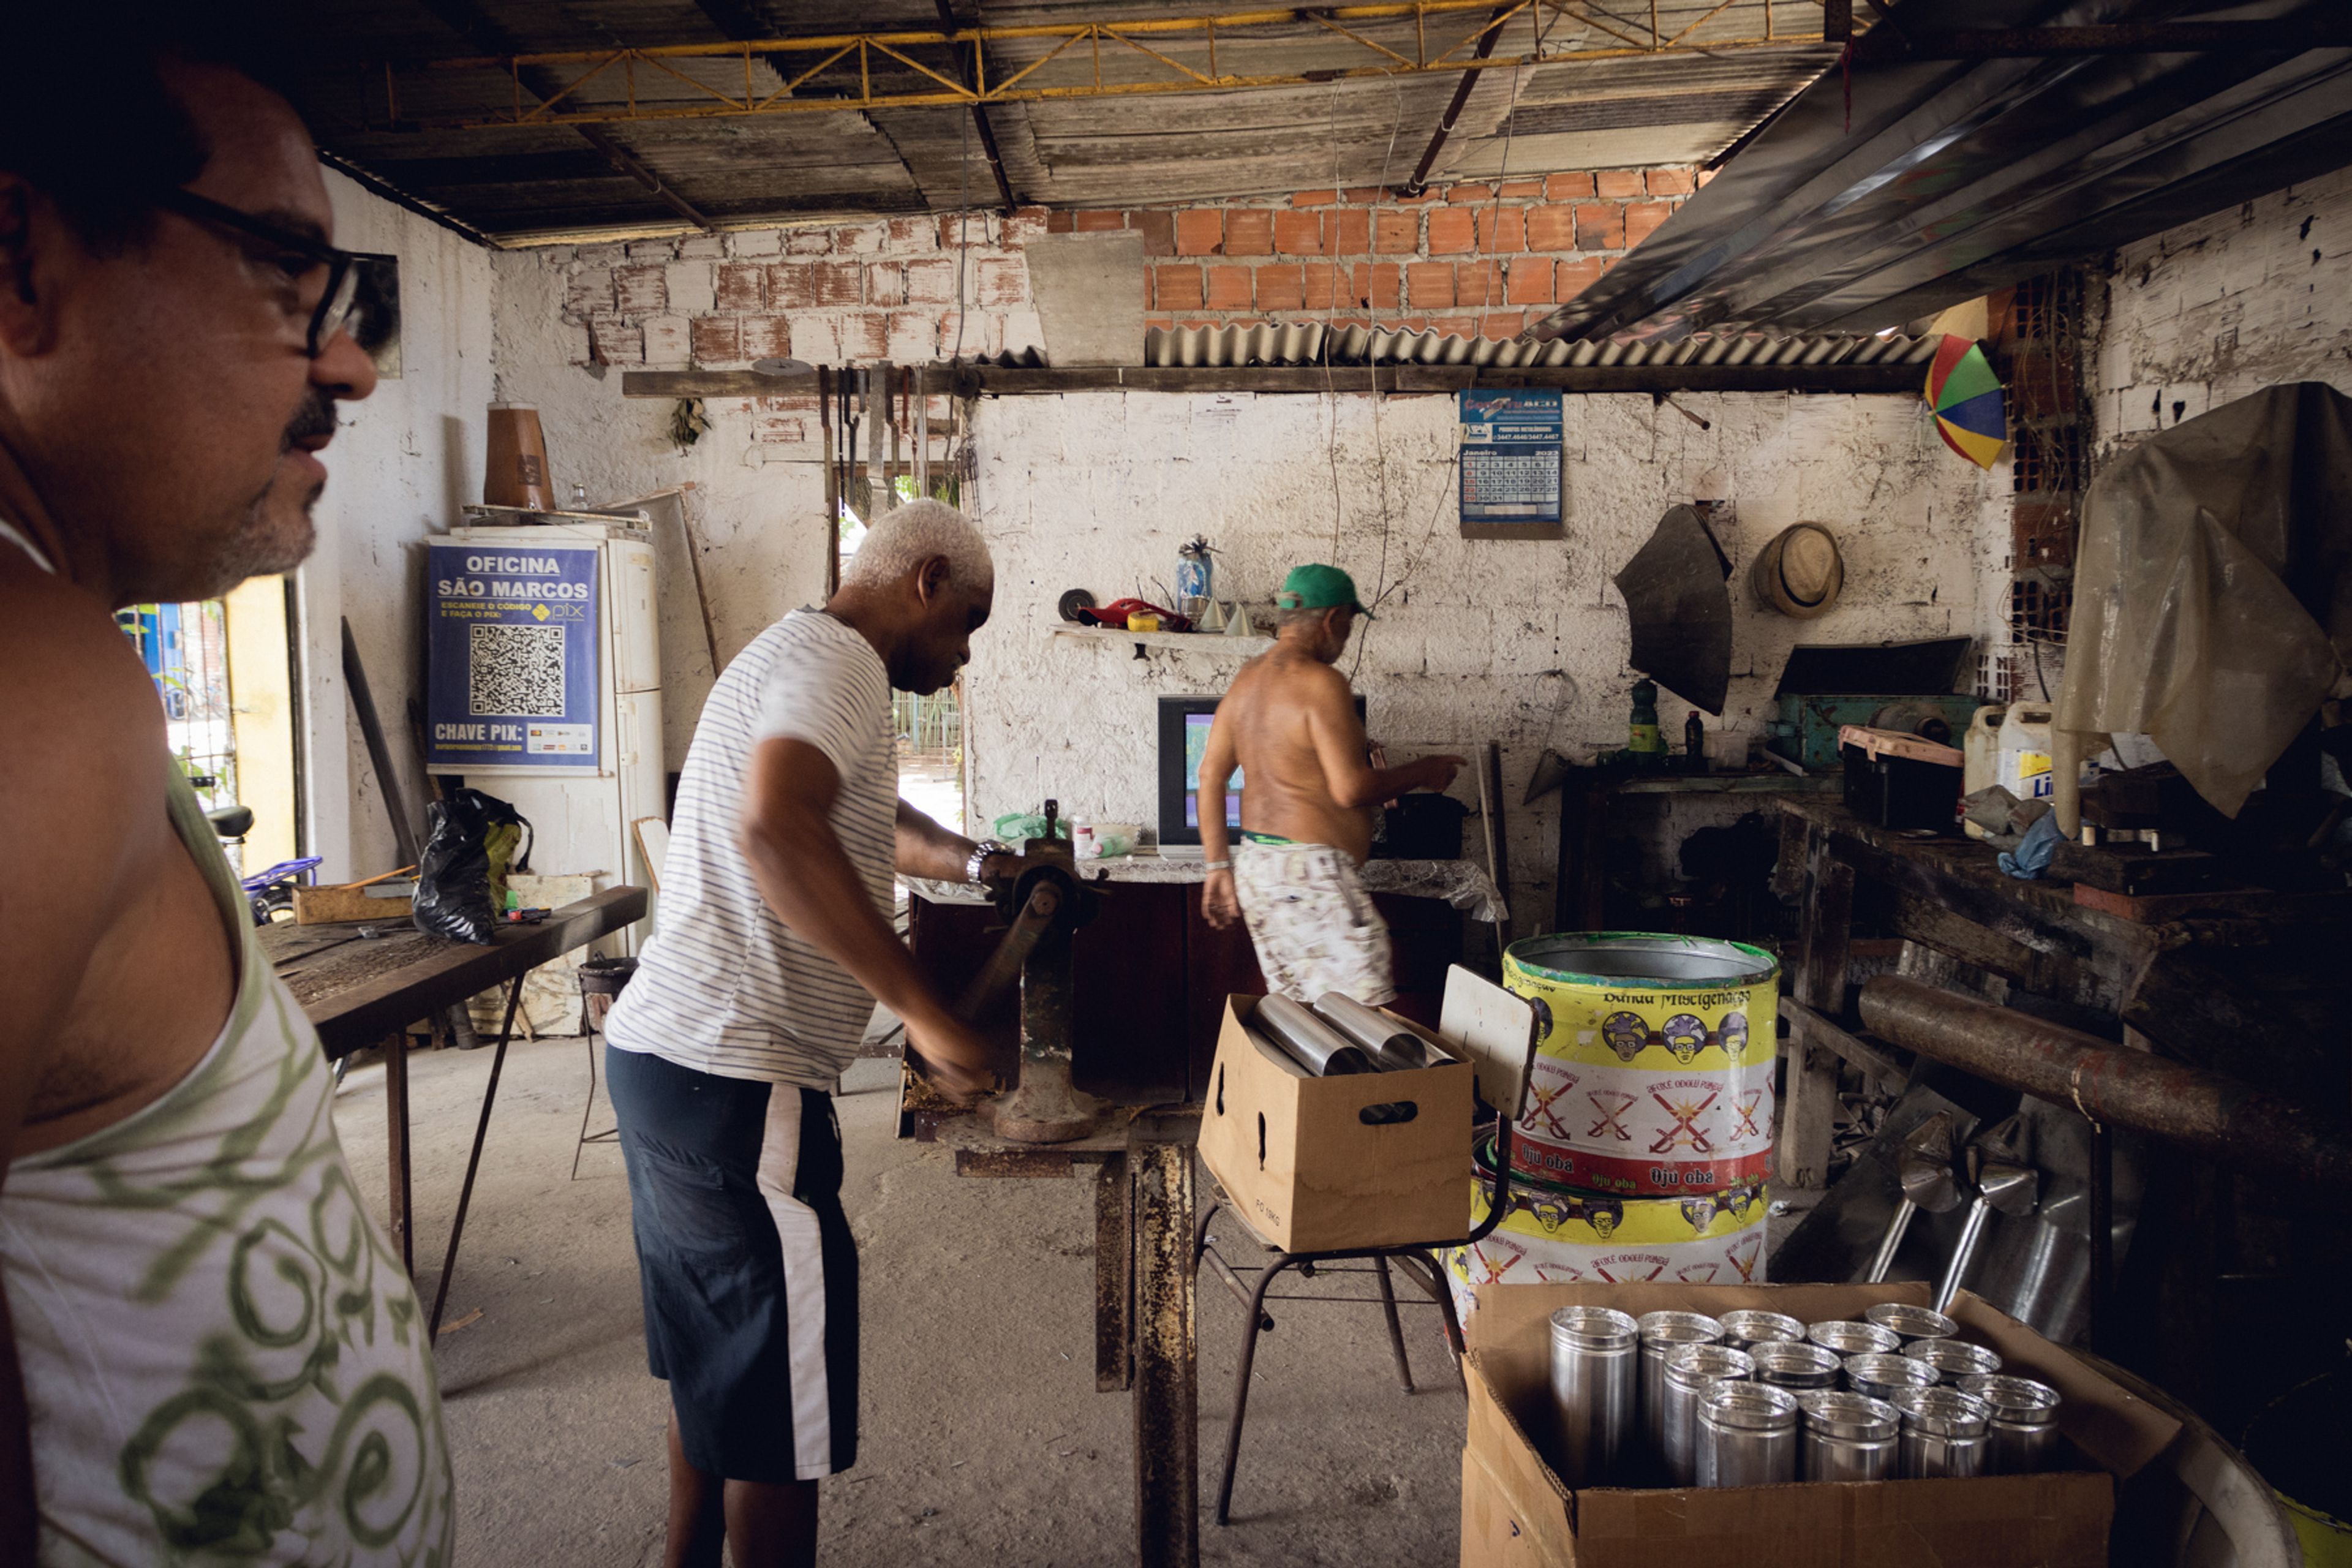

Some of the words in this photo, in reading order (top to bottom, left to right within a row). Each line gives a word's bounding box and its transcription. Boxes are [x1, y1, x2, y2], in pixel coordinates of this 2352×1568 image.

[467, 556, 560, 573] OFICINA
[437, 578, 485, 596] SÃO
[492, 581, 588, 598] MARCOS
[435, 724, 486, 740] CHAVE
[491, 724, 522, 741] PIX:
[2034, 775, 2054, 797] Li
[1650, 1167, 1679, 1188] Oju
